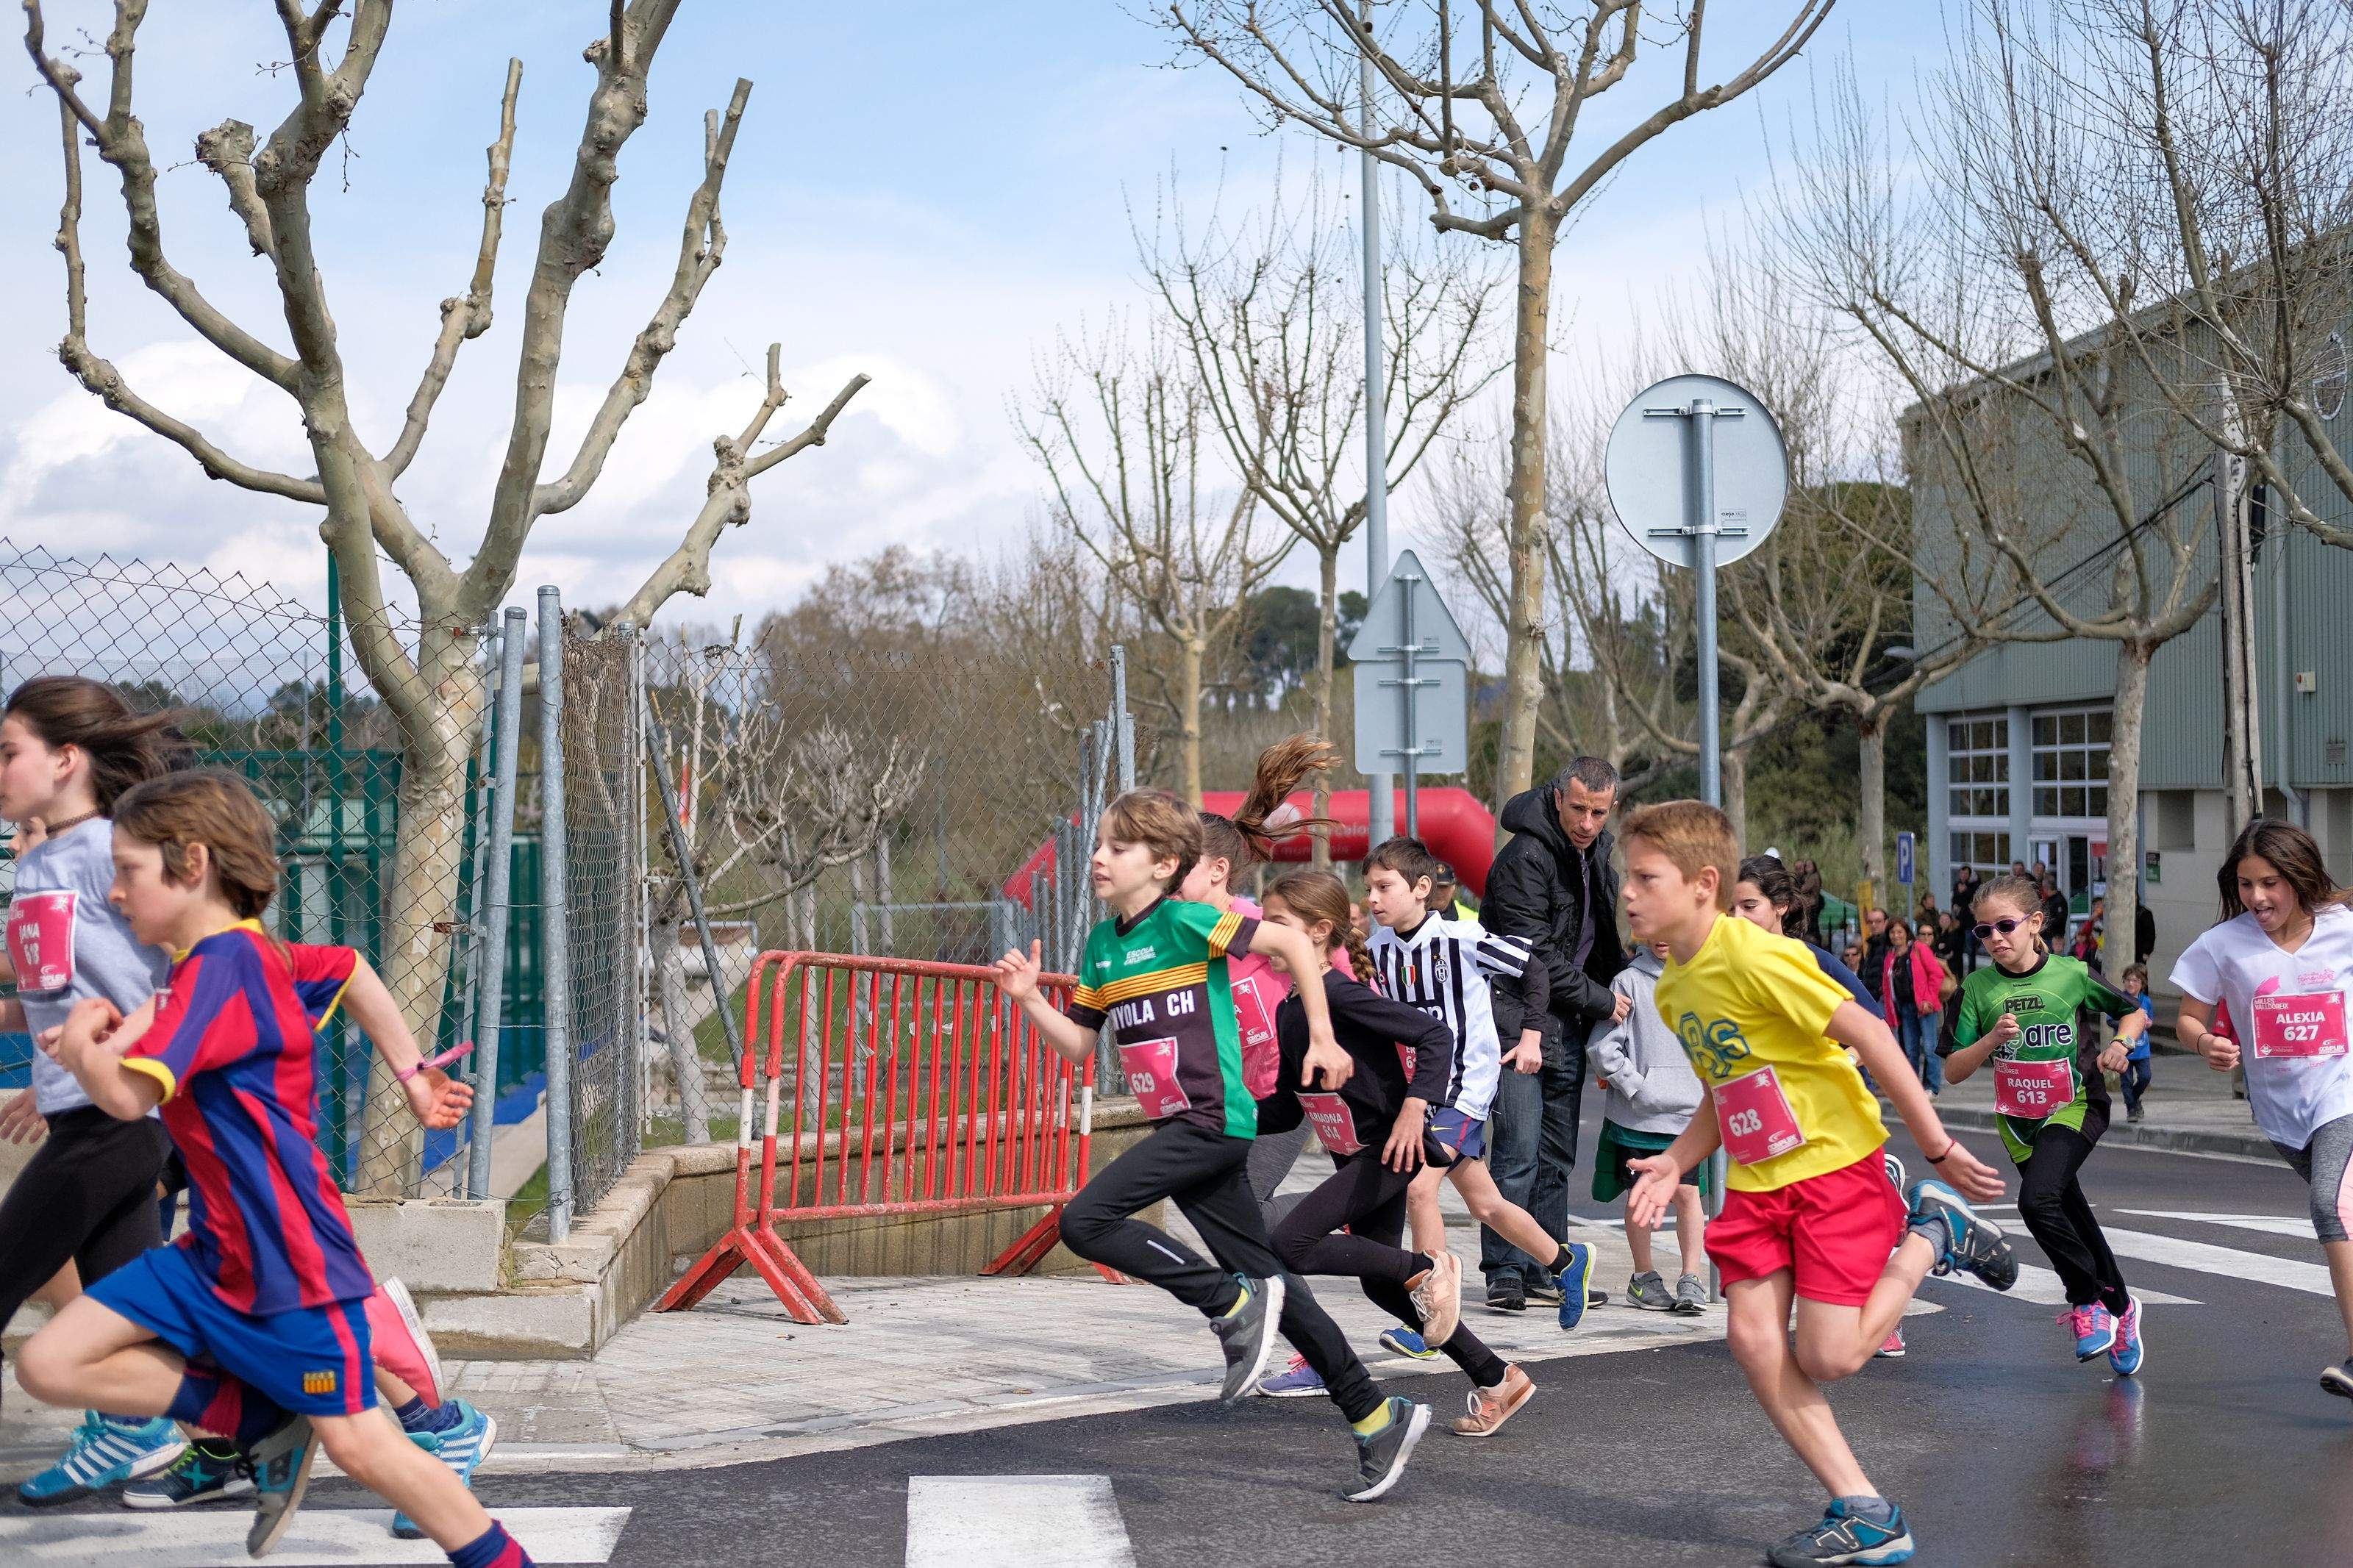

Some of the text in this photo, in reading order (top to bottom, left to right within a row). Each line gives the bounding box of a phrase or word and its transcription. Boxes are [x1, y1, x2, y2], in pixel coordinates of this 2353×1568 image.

[1901, 839, 1909, 878] P
[19, 922, 40, 945] JANA
[1166, 989, 1195, 1017] CH
[2004, 996, 2046, 1013] PETZL
[2276, 1012, 2326, 1024] ALEXIA
[2284, 1025, 2318, 1041] 627
[1131, 1072, 1155, 1093] 629
[2007, 1078, 2054, 1089] RAQUEL
[2016, 1090, 2047, 1104] 613
[1309, 1112, 1343, 1123] ARIADNA
[1728, 1109, 1763, 1136] 628
[1322, 1125, 1341, 1140] 614
